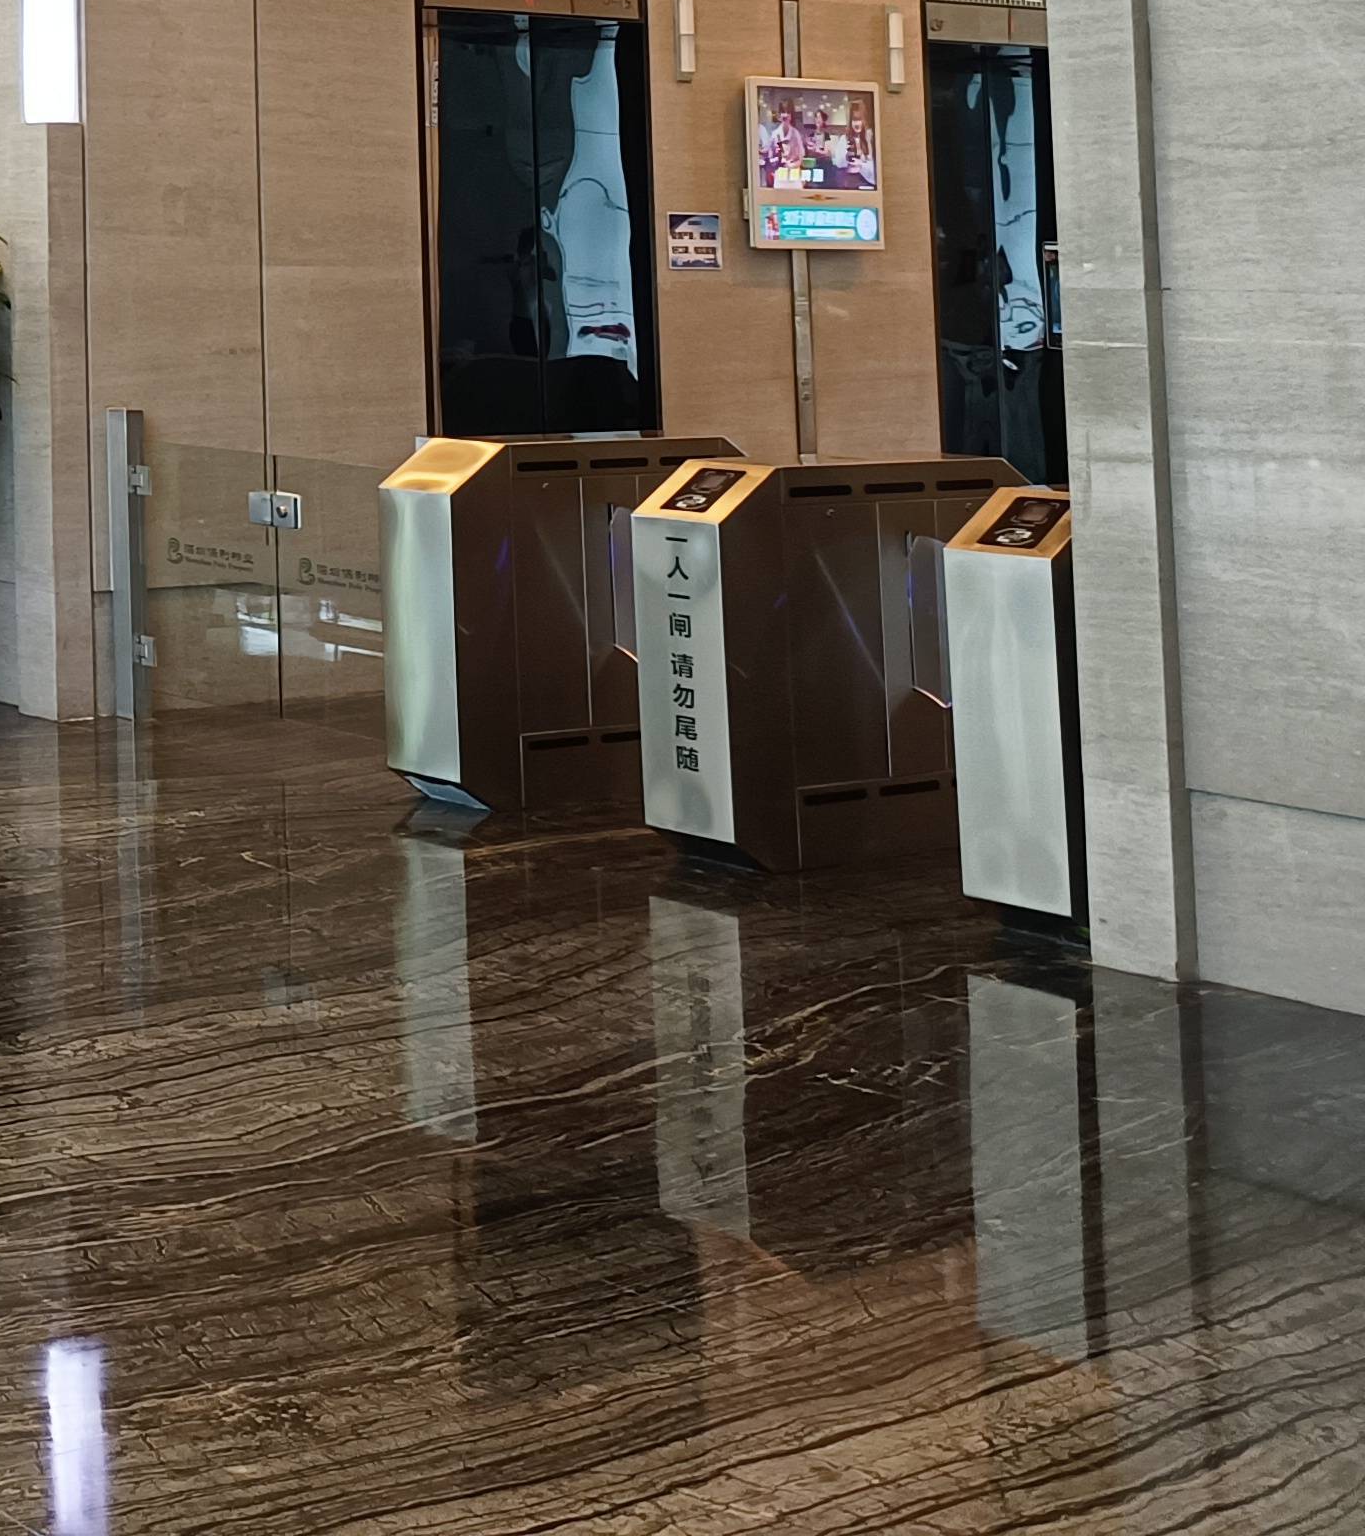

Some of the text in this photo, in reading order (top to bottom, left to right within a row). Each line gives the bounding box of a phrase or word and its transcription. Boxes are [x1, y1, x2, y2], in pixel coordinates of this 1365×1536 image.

[665, 534, 701, 773] 一人一闸 请勿尾随
